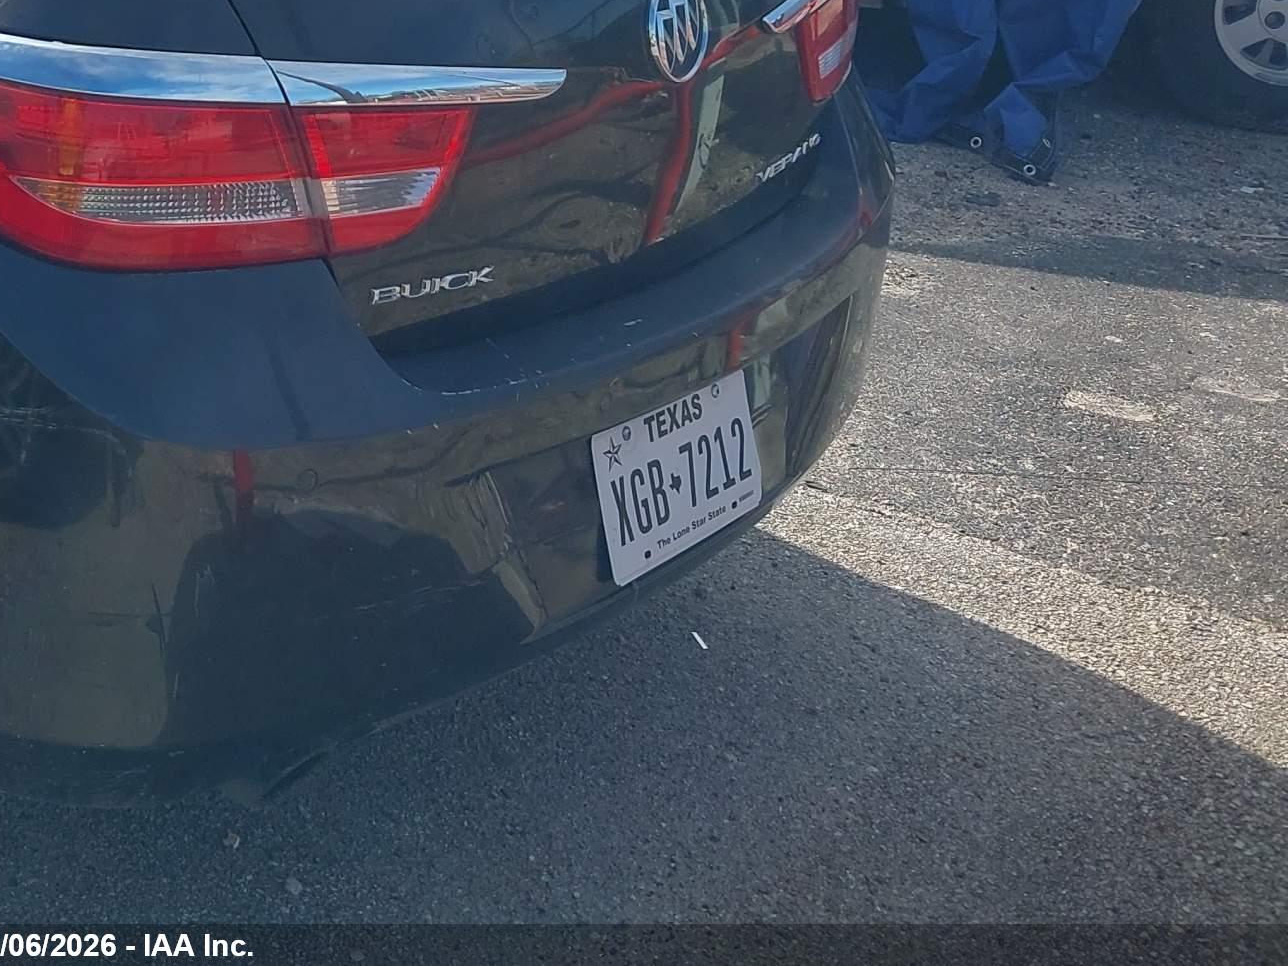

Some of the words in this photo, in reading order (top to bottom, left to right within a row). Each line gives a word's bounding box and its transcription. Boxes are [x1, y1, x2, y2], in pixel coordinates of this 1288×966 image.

[371, 265, 495, 305] BUICK
[643, 393, 703, 443] TEXAS
[657, 537, 672, 549] The
[672, 526, 690, 541] Lone
[691, 516, 707, 530] Star
[708, 505, 727, 521] State
